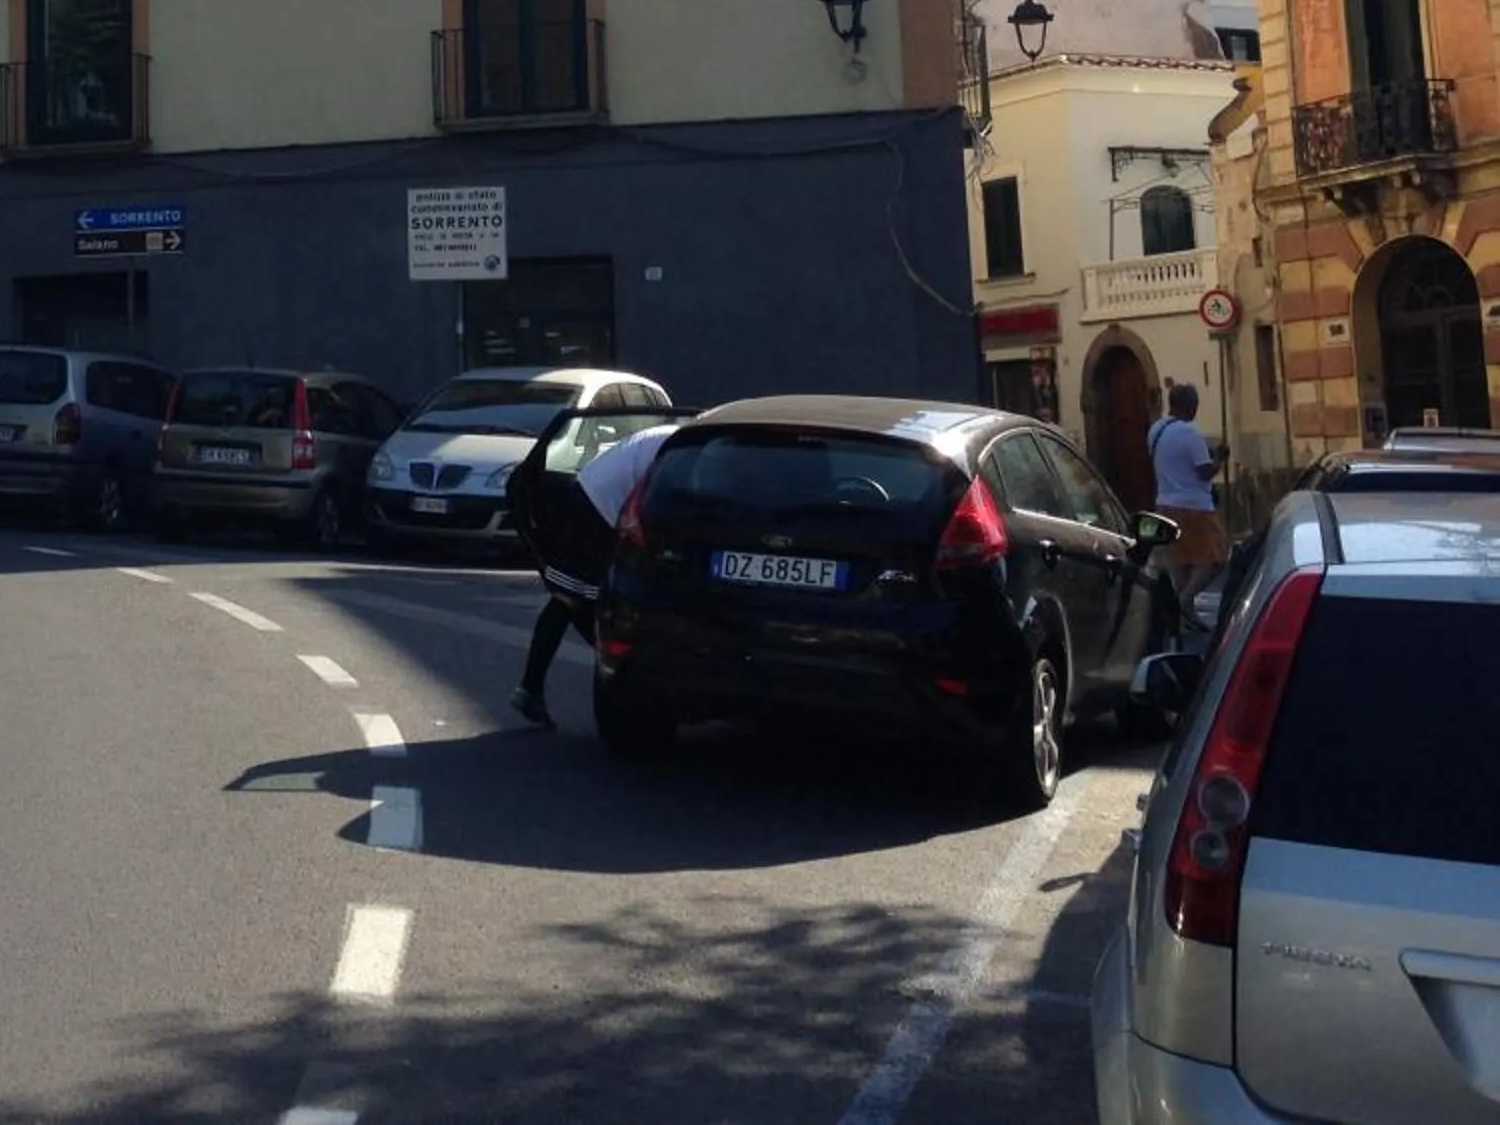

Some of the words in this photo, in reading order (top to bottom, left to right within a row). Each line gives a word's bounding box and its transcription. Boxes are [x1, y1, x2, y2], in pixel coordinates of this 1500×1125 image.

[109, 210, 182, 225] SORRENTO
[411, 215, 503, 230] SORRENTO
[724, 554, 754, 579] DZ
[761, 557, 835, 585] 685LF
